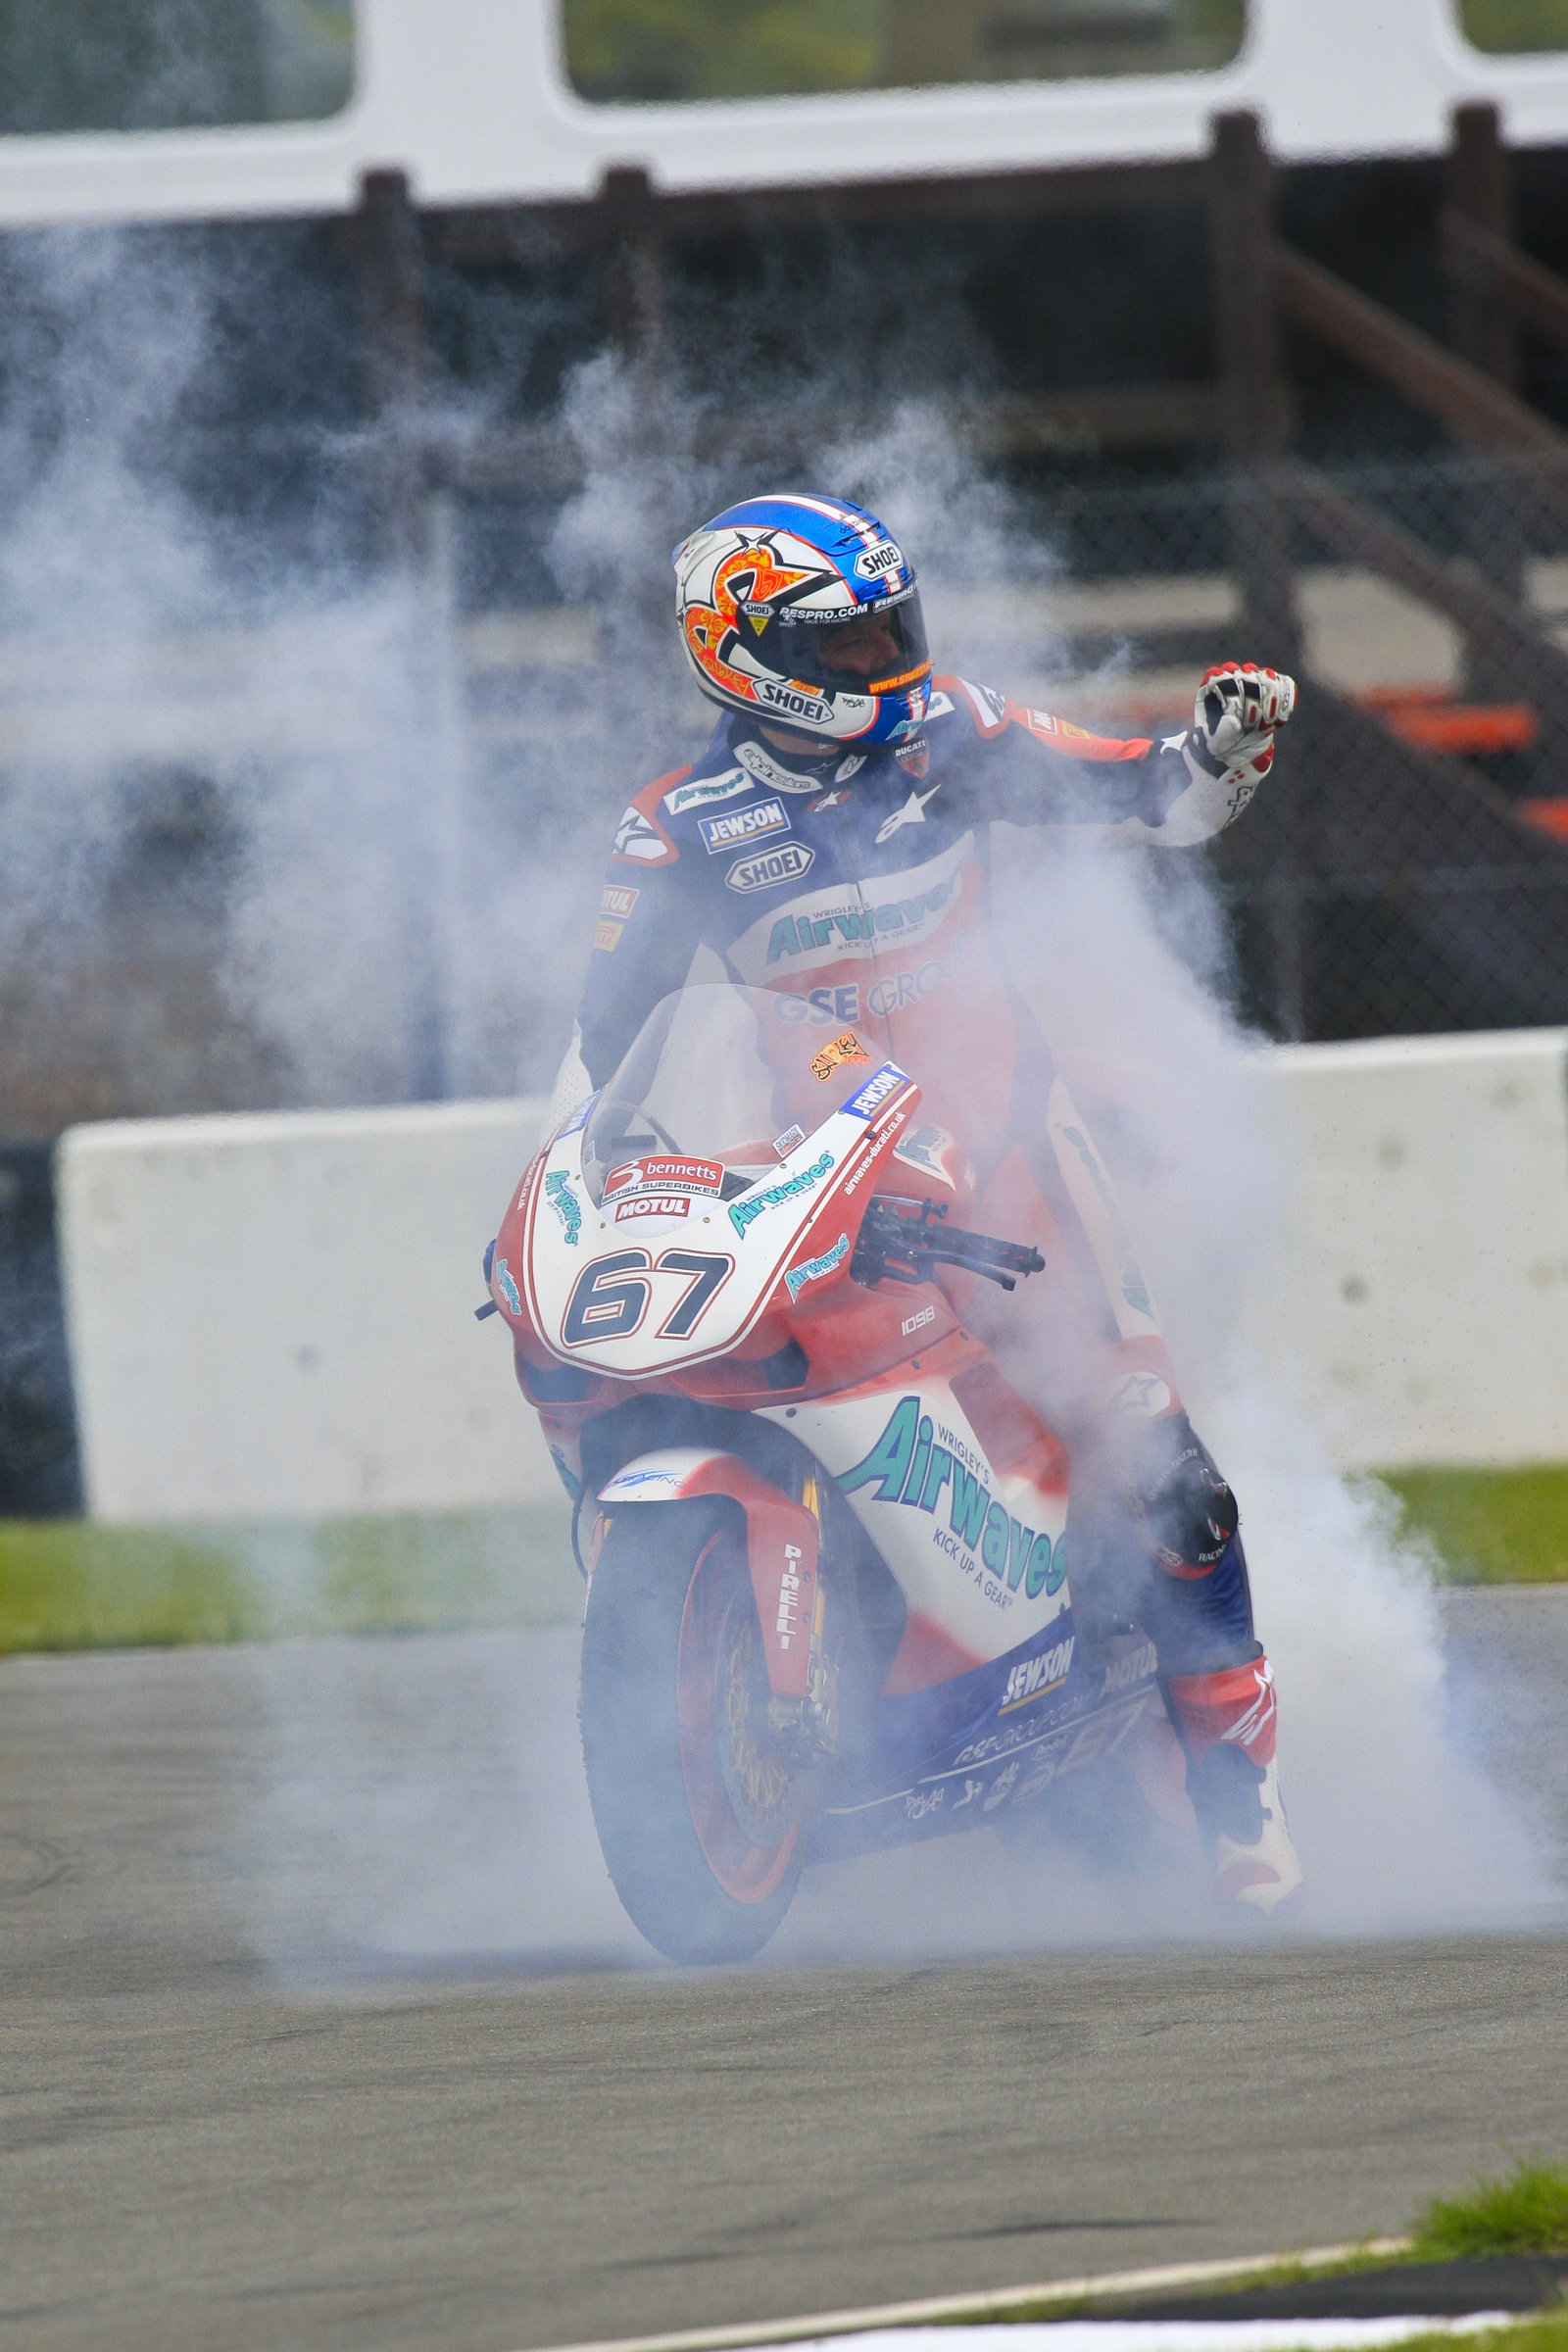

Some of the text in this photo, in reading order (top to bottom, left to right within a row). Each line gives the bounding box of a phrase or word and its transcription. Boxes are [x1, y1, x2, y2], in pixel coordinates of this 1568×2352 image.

[745, 604, 770, 615] SHOEI
[779, 603, 868, 619] RESPRO.COM
[762, 684, 824, 721] SHOEI
[895, 740, 926, 758] DUCATI
[710, 803, 783, 842] JEWSON
[739, 849, 803, 887] SHOEI
[774, 985, 859, 1025] GSE
[851, 1070, 901, 1115] JEWSON
[642, 1181, 719, 1196] SUPERBIKES
[647, 1161, 717, 1181] bennetts
[545, 1170, 582, 1246] Airwaves
[616, 1198, 687, 1220] MOTUL
[728, 1152, 835, 1241] Airwaves
[785, 1235, 850, 1300] Airwaves
[563, 1249, 733, 1348] 67
[901, 1305, 936, 1337] 1098
[937, 1423, 990, 1485] WRIGLEY'S
[833, 1396, 1066, 1599] Airwaves
[933, 1528, 957, 1560] KICK
[959, 1552, 975, 1575] UP
[973, 1571, 983, 1588] A
[776, 1544, 802, 1650] PIRELLI
[1003, 1636, 1075, 1706] JEWSON
